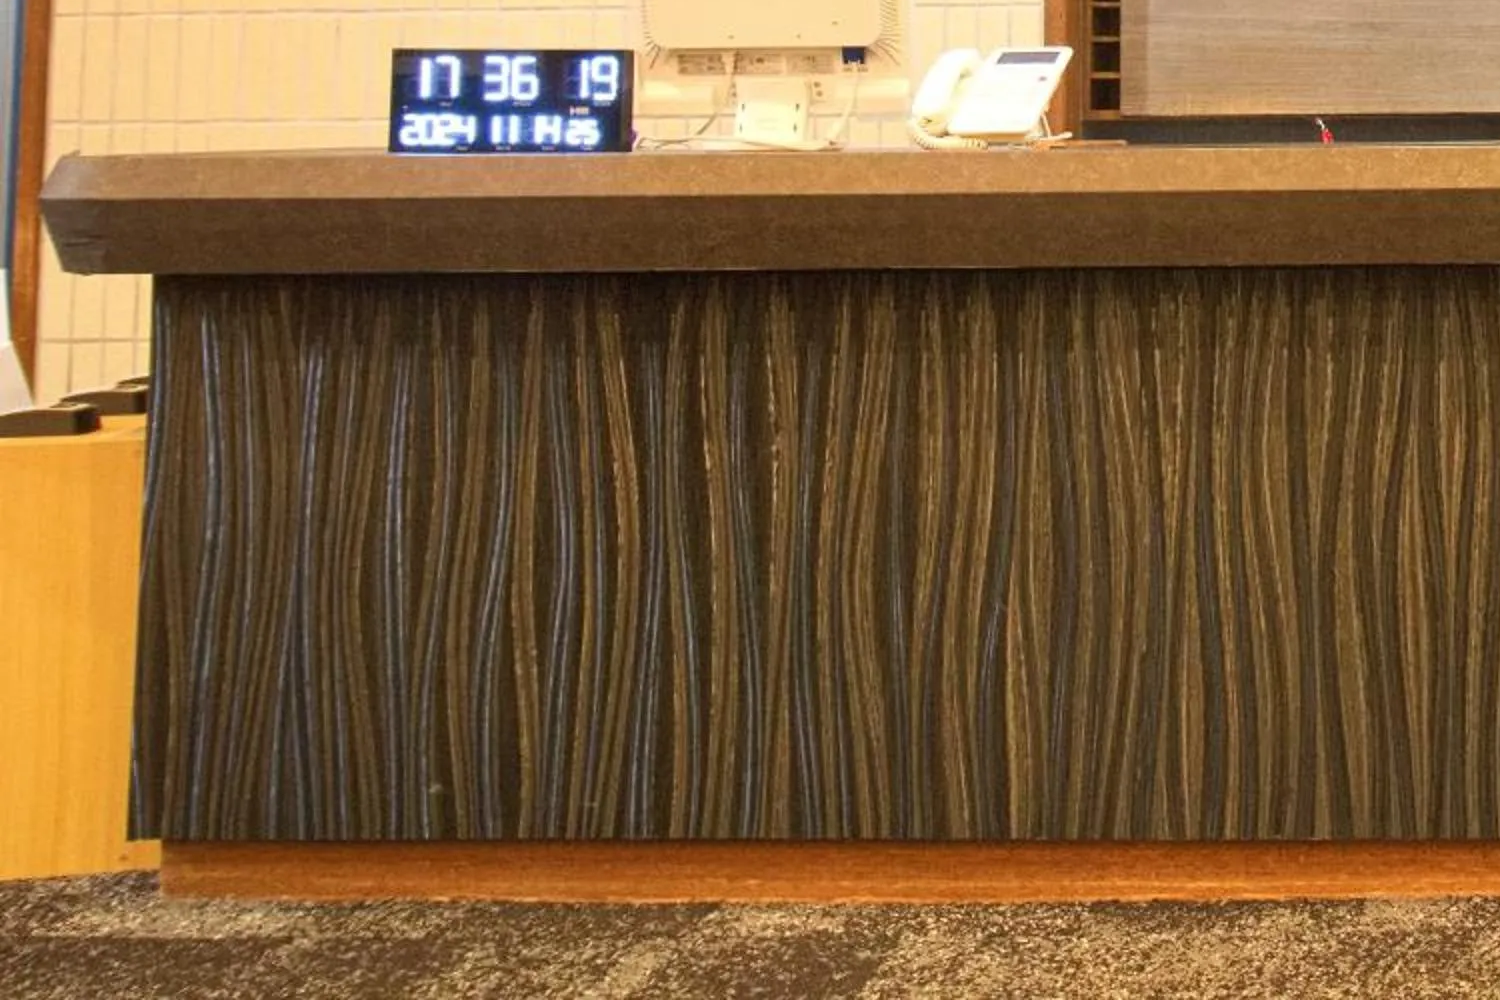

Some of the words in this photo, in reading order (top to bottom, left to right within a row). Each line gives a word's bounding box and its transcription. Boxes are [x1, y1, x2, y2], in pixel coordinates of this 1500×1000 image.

[418, 55, 461, 99] 17
[483, 55, 540, 102] 36
[578, 55, 620, 102] 19
[399, 112, 477, 146] 2024
